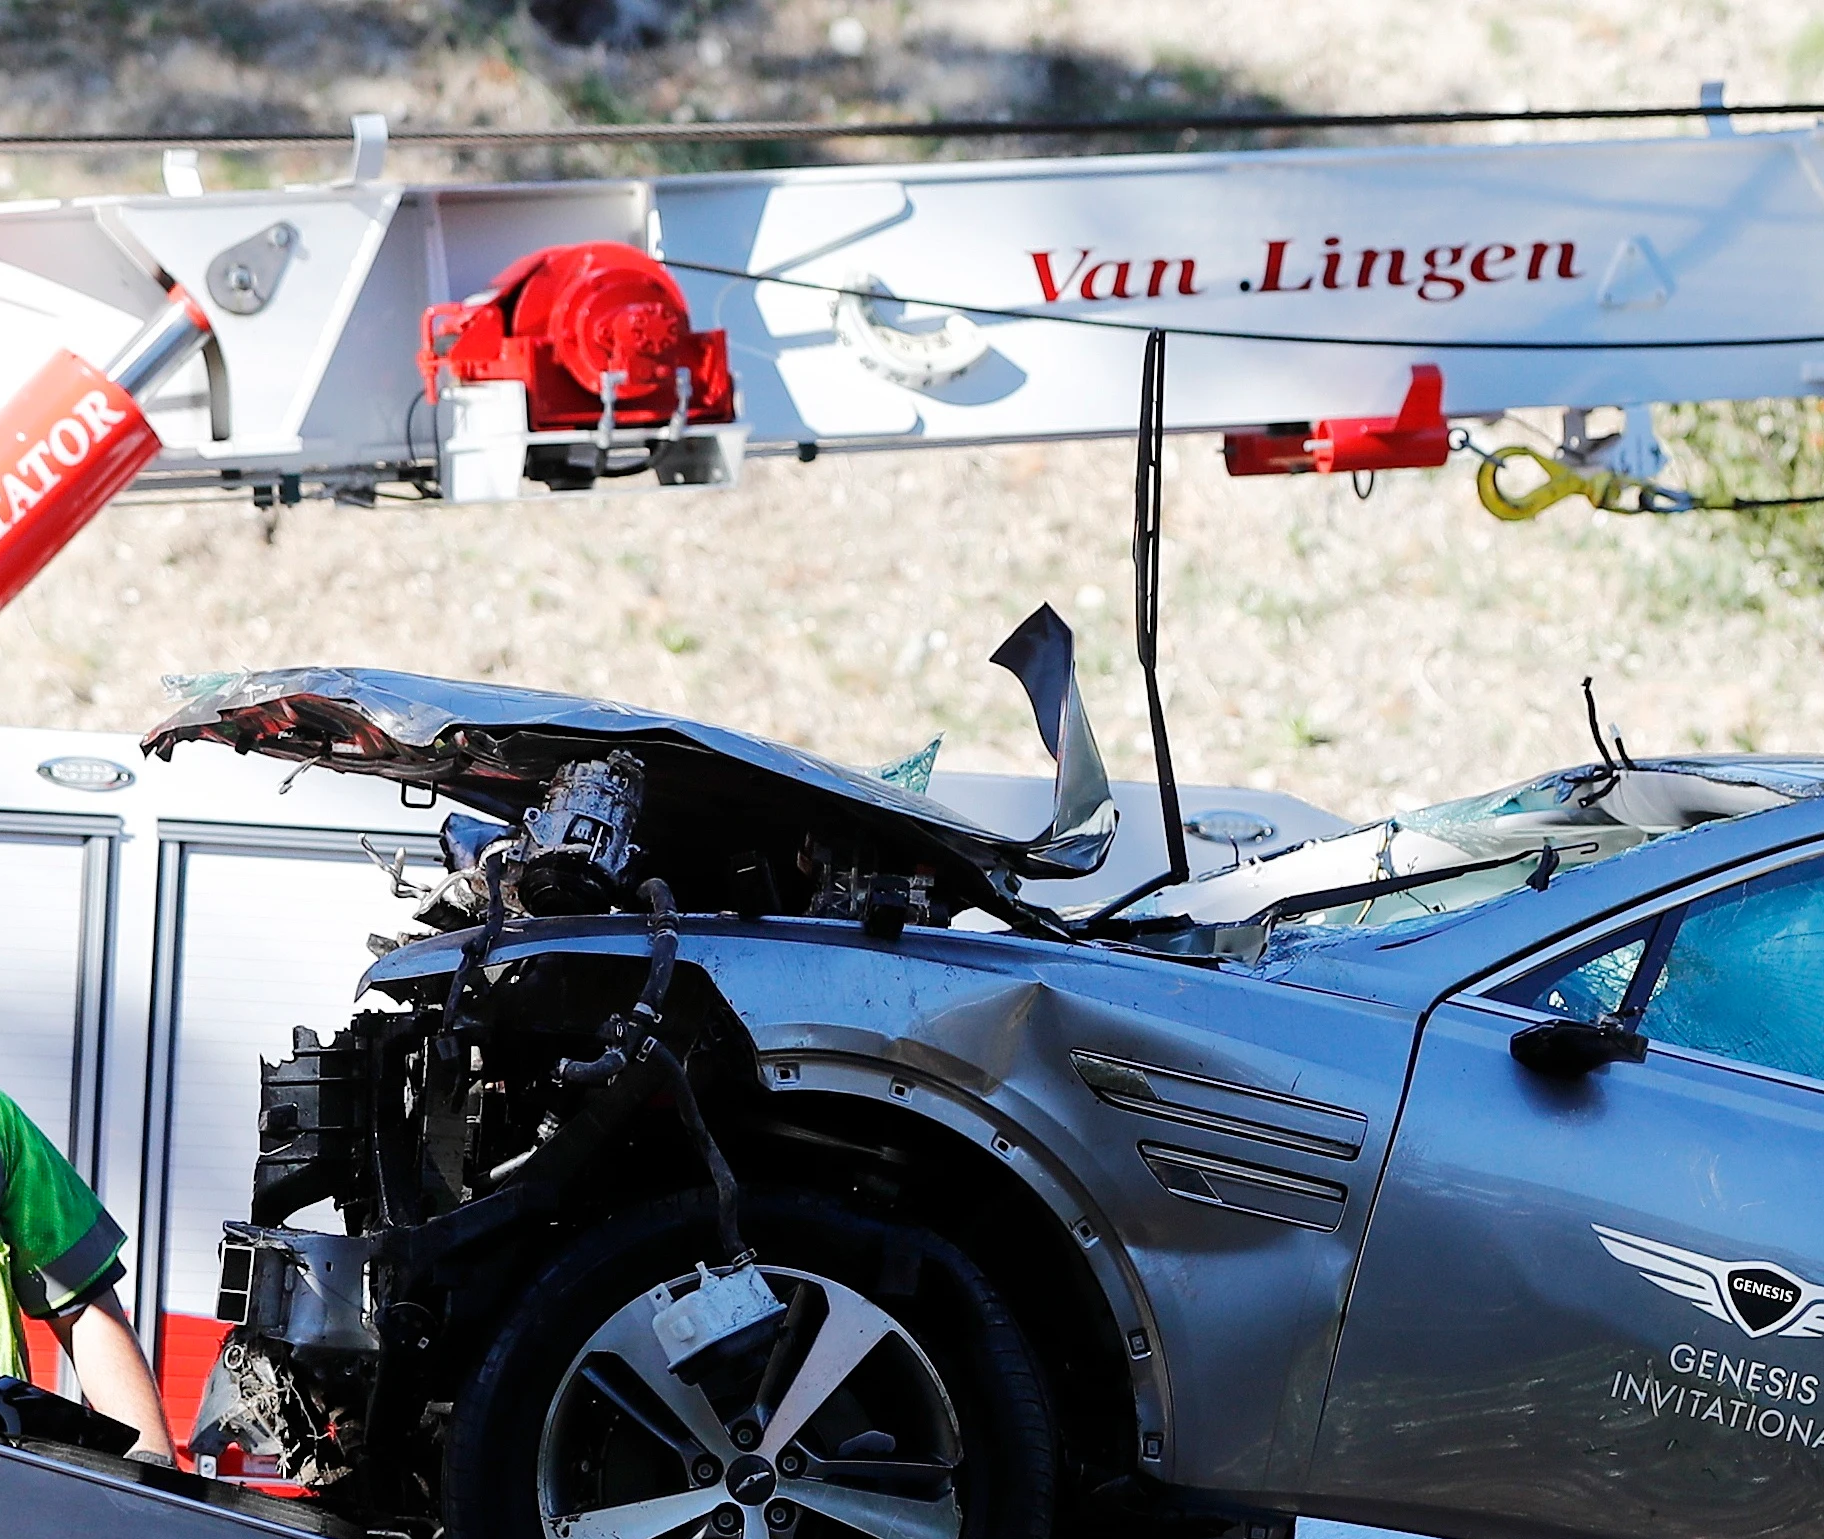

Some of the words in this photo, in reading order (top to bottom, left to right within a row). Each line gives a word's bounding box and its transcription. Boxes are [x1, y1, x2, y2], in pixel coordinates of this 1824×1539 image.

[1028, 248, 1206, 303] Van
[1256, 236, 1584, 302] Lingen
[1732, 1276, 1795, 1304] GENESIS
[1669, 1343, 1821, 1406] GENESIS
